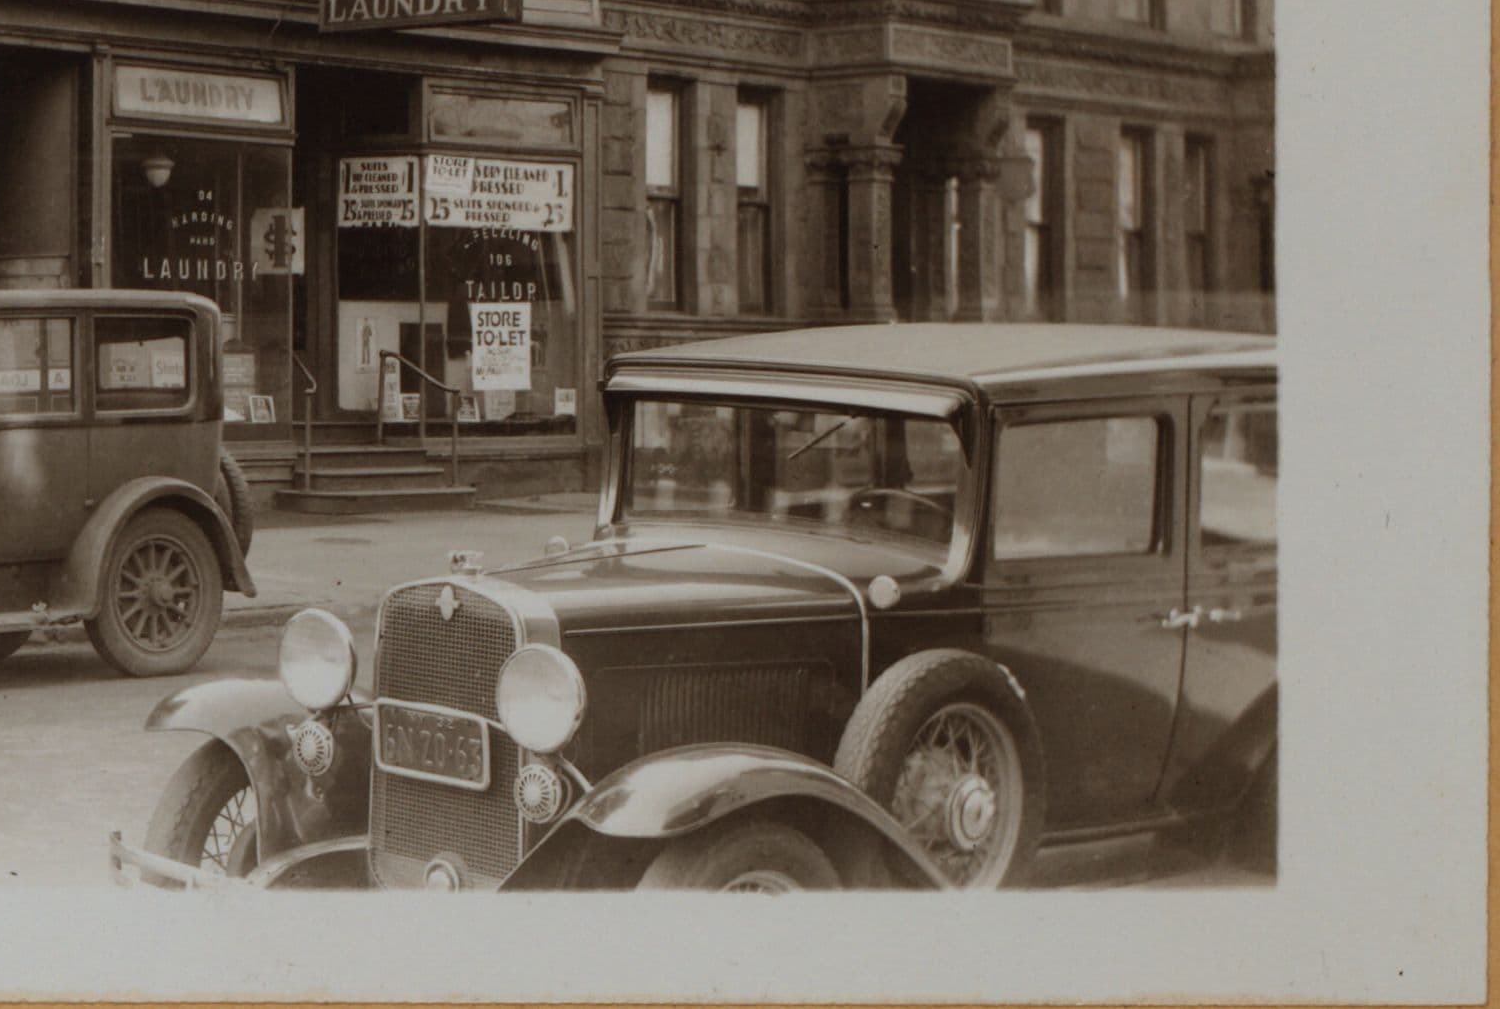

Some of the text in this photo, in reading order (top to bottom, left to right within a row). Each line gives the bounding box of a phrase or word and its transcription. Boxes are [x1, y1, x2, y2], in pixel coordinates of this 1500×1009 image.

[139, 76, 255, 111] LAUNDRY
[430, 197, 450, 221] 25
[453, 198, 482, 209] SUITS
[489, 253, 514, 267] 106
[465, 280, 537, 302] TAILOR
[477, 311, 522, 328] STORE
